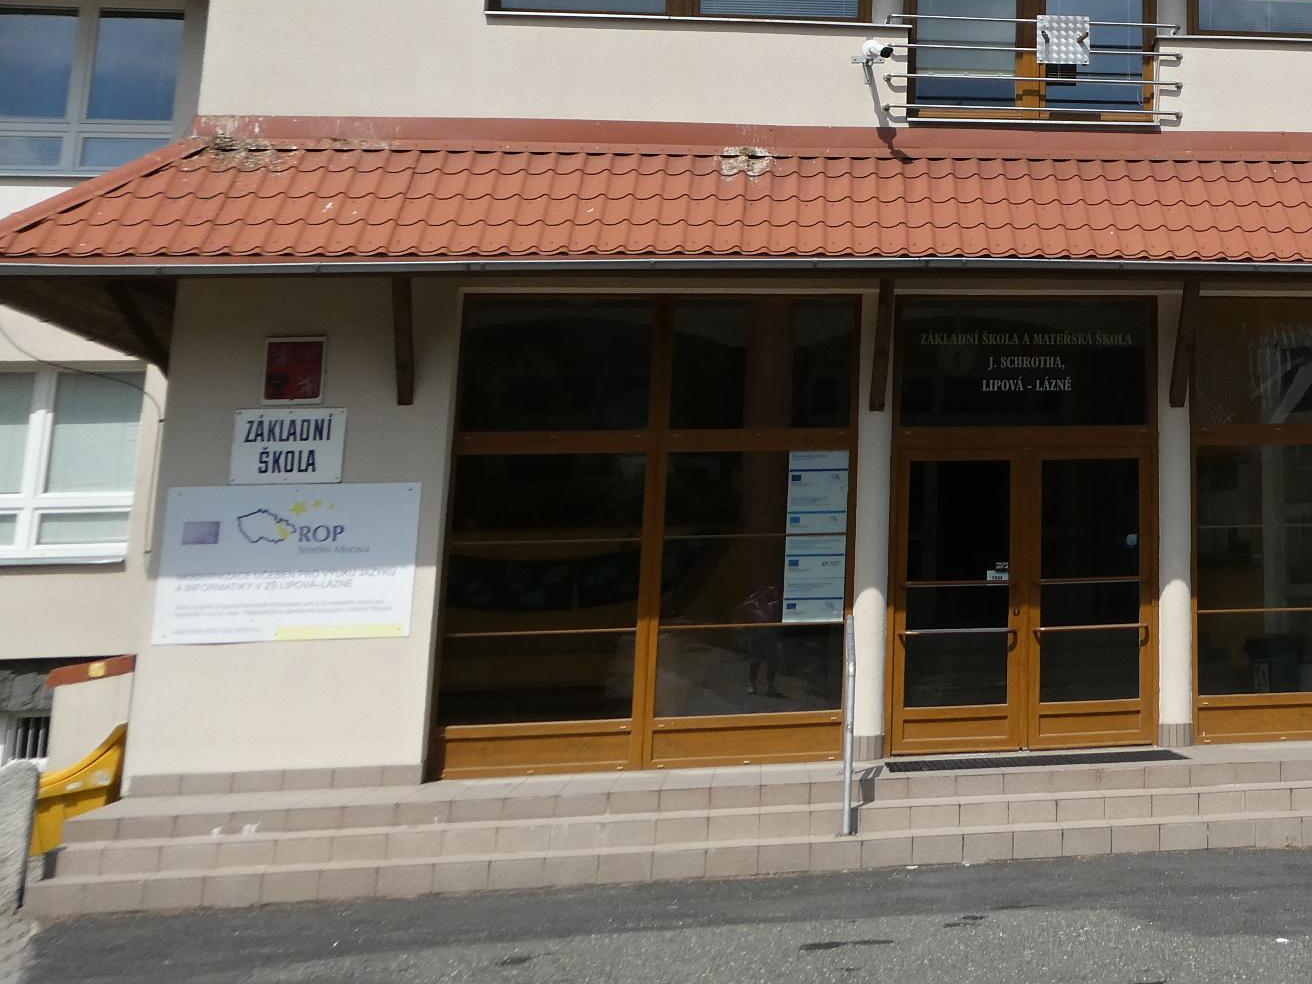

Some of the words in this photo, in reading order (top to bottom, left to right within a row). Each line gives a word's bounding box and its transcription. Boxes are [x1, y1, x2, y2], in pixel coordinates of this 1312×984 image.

[920, 330, 979, 345] ZÁKLADNÍ
[982, 330, 1019, 345] ŠKOLA
[1022, 332, 1030, 345] A
[1033, 330, 1093, 345] MATEŘSKÁ
[1095, 330, 1133, 345] ŠKOLA
[987, 356, 998, 370] J.
[1000, 356, 1066, 371] SCHROTHA,
[982, 376, 1024, 391] LIPOVÁ
[1035, 376, 1072, 391] LÁZNĚ
[243, 413, 333, 443] ZÁKLADNÍ
[258, 446, 317, 474] ŠKOLA
[298, 524, 345, 543] ROP
[334, 544, 370, 553] Morava
